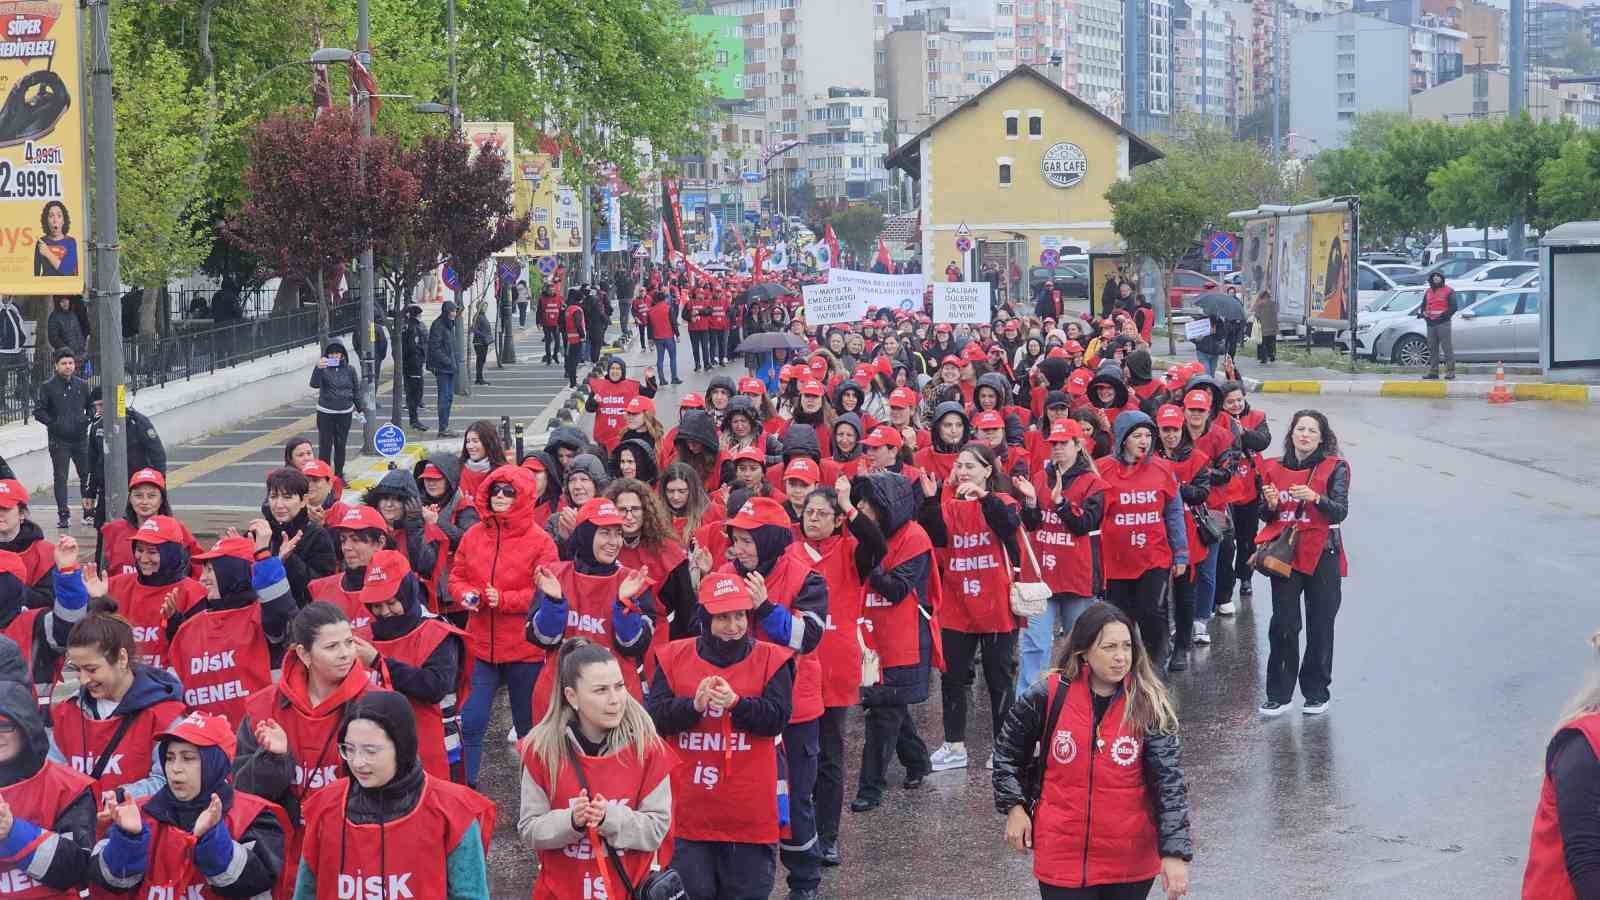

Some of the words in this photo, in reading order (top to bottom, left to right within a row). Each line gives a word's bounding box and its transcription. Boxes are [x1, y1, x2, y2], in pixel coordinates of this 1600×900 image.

[8, 15, 41, 35] SÜPER
[1043, 161, 1061, 171] GAR
[1063, 160, 1086, 171] CAFE
[0, 161, 61, 197] 2.999TL
[1119, 489, 1157, 505] DİSK
[1115, 511, 1161, 525] GENEL
[953, 532, 991, 549] DİSK
[1131, 530, 1146, 549] İŞ
[1042, 552, 1057, 571] İŞ
[963, 577, 981, 597] İŞ
[132, 625, 160, 642] SK
[191, 649, 236, 675] DİSK
[185, 680, 250, 706] GENEL
[679, 731, 752, 751] GENEL
[694, 760, 720, 790] İŞ
[338, 869, 415, 900] DİSK
